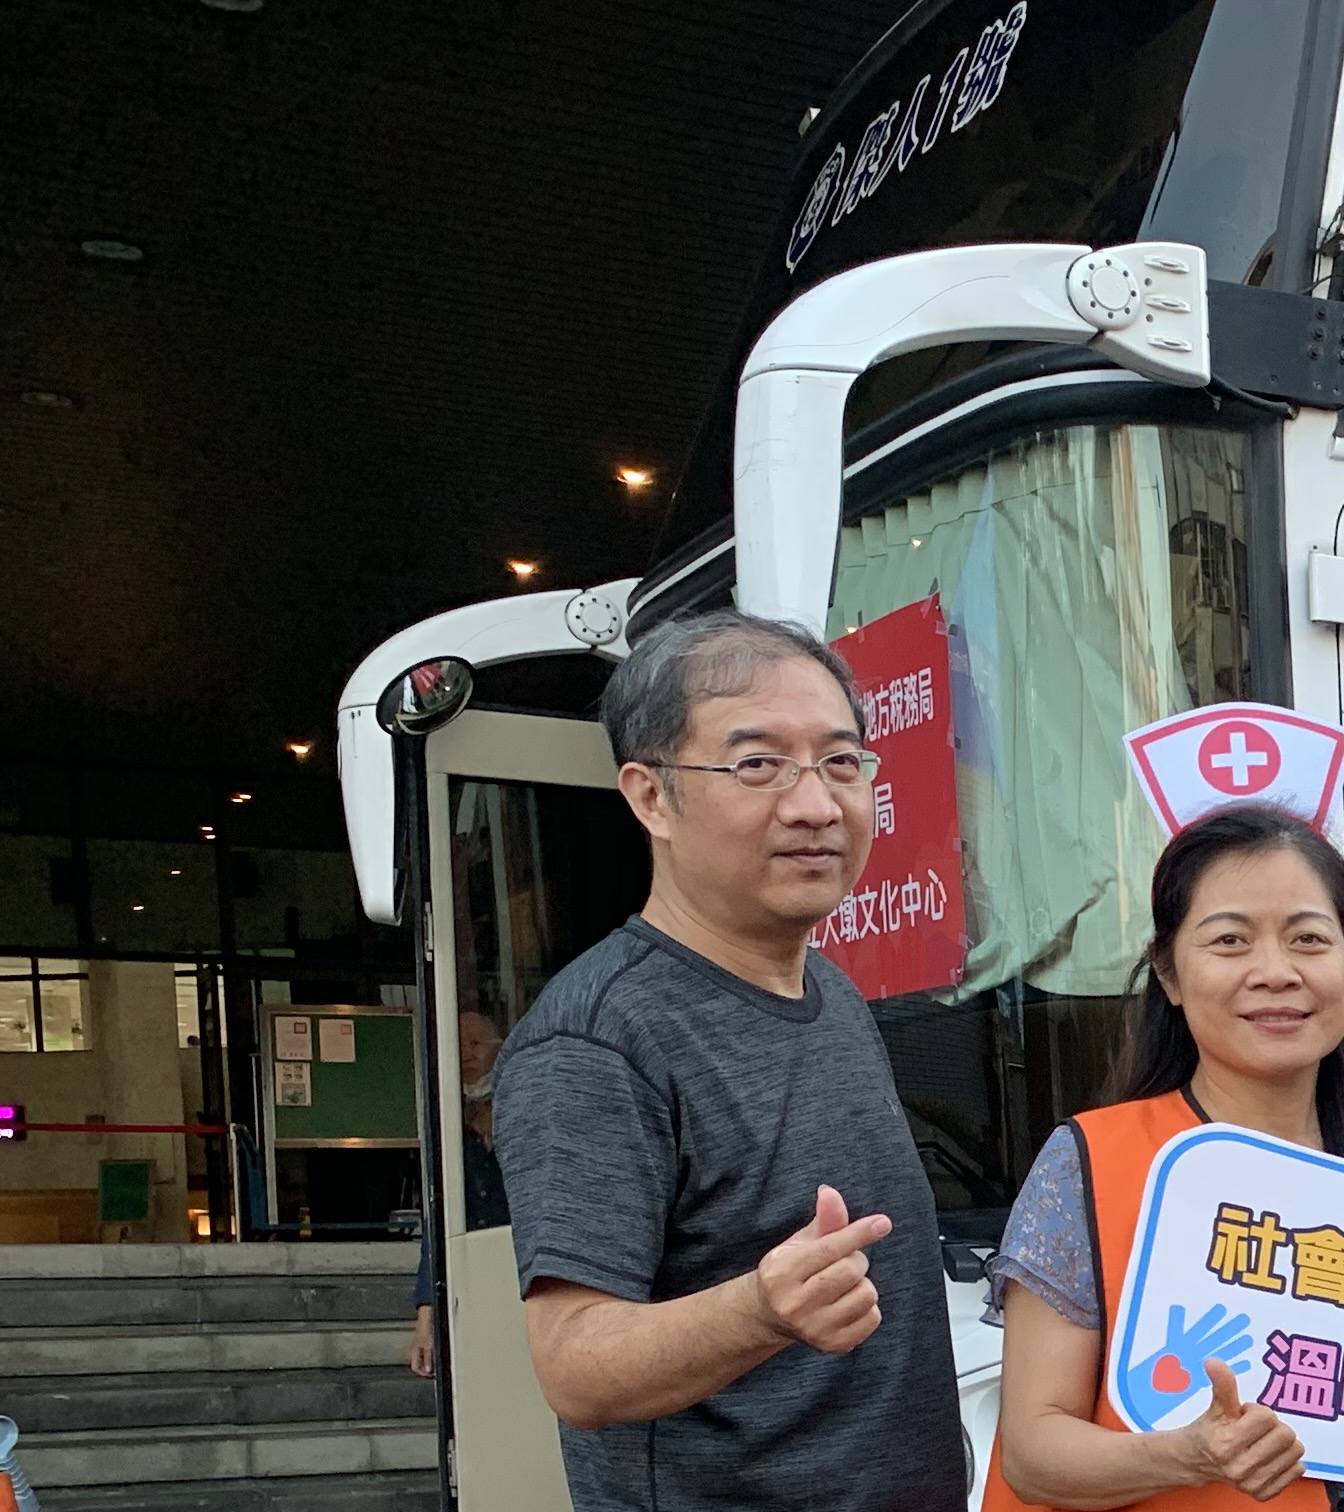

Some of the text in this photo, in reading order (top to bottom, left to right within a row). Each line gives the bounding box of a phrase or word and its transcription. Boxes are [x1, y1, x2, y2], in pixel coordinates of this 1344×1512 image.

[859, 667, 934, 743] 地方稅務局
